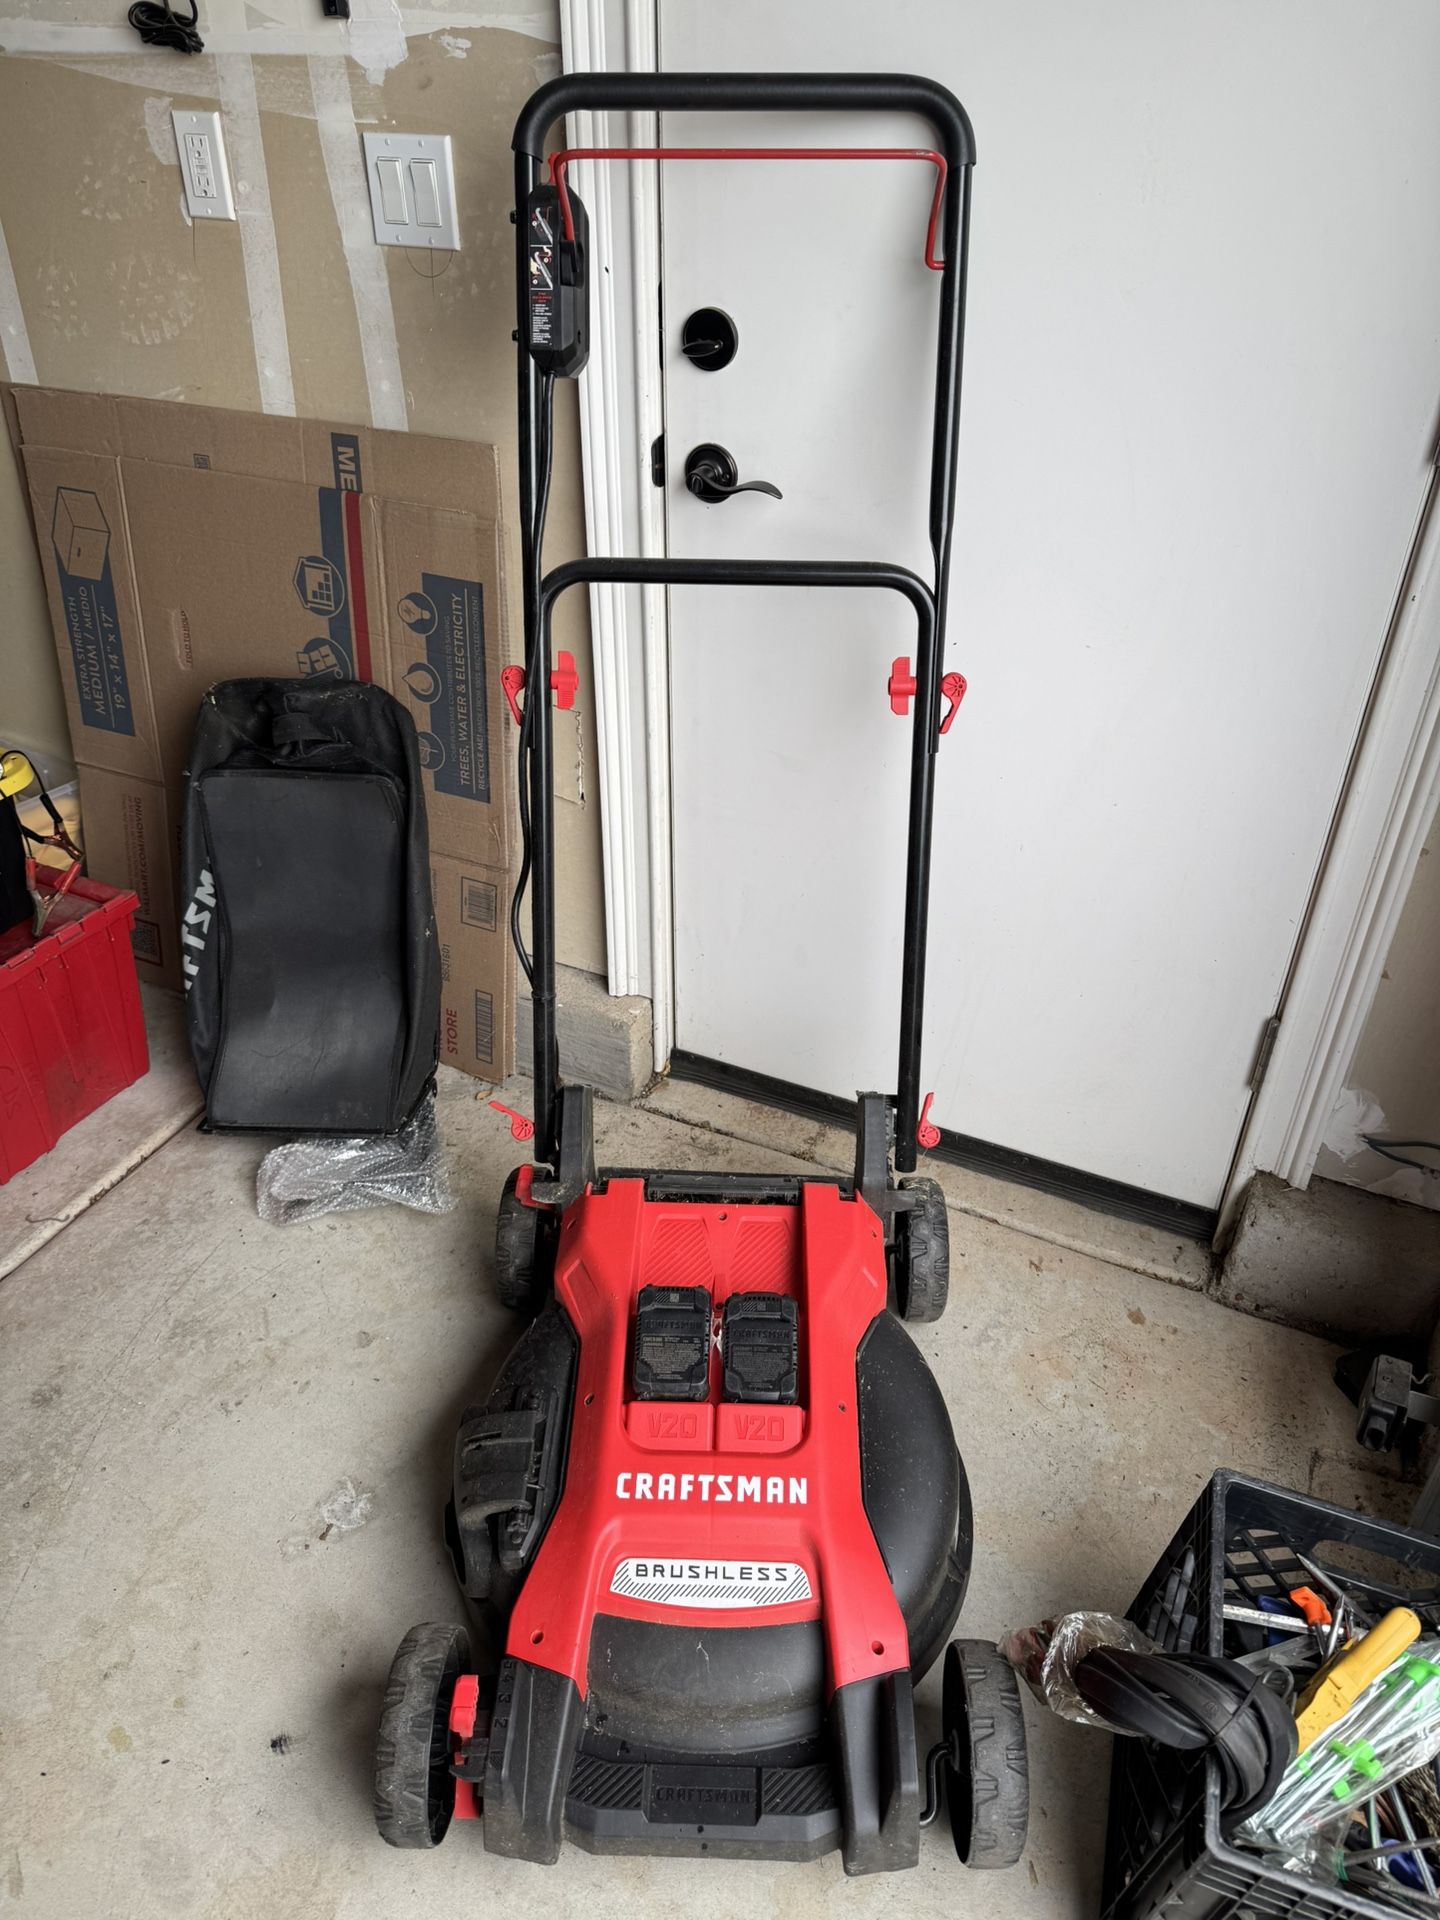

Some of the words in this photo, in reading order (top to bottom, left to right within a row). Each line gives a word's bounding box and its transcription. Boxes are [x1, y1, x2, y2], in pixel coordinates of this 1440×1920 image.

[79, 586, 94, 629] MEDIO
[67, 597, 86, 660] STRENGTH
[451, 592, 465, 680] ELECTRICITY
[80, 663, 91, 700] EXTRA
[87, 645, 106, 715] MEDIUM
[456, 684, 466, 693] &
[457, 696, 468, 741] WATER
[477, 752, 486, 790] RECYCLE
[445, 1008, 458, 1054] STORE
[648, 1413, 697, 1438] V20
[735, 1415, 785, 1441] V20
[616, 1472, 808, 1504] CRAFTSMAN
[635, 1564, 788, 1581] BRUSHLESS
[656, 1787, 750, 1802] CRAFTSMAN
